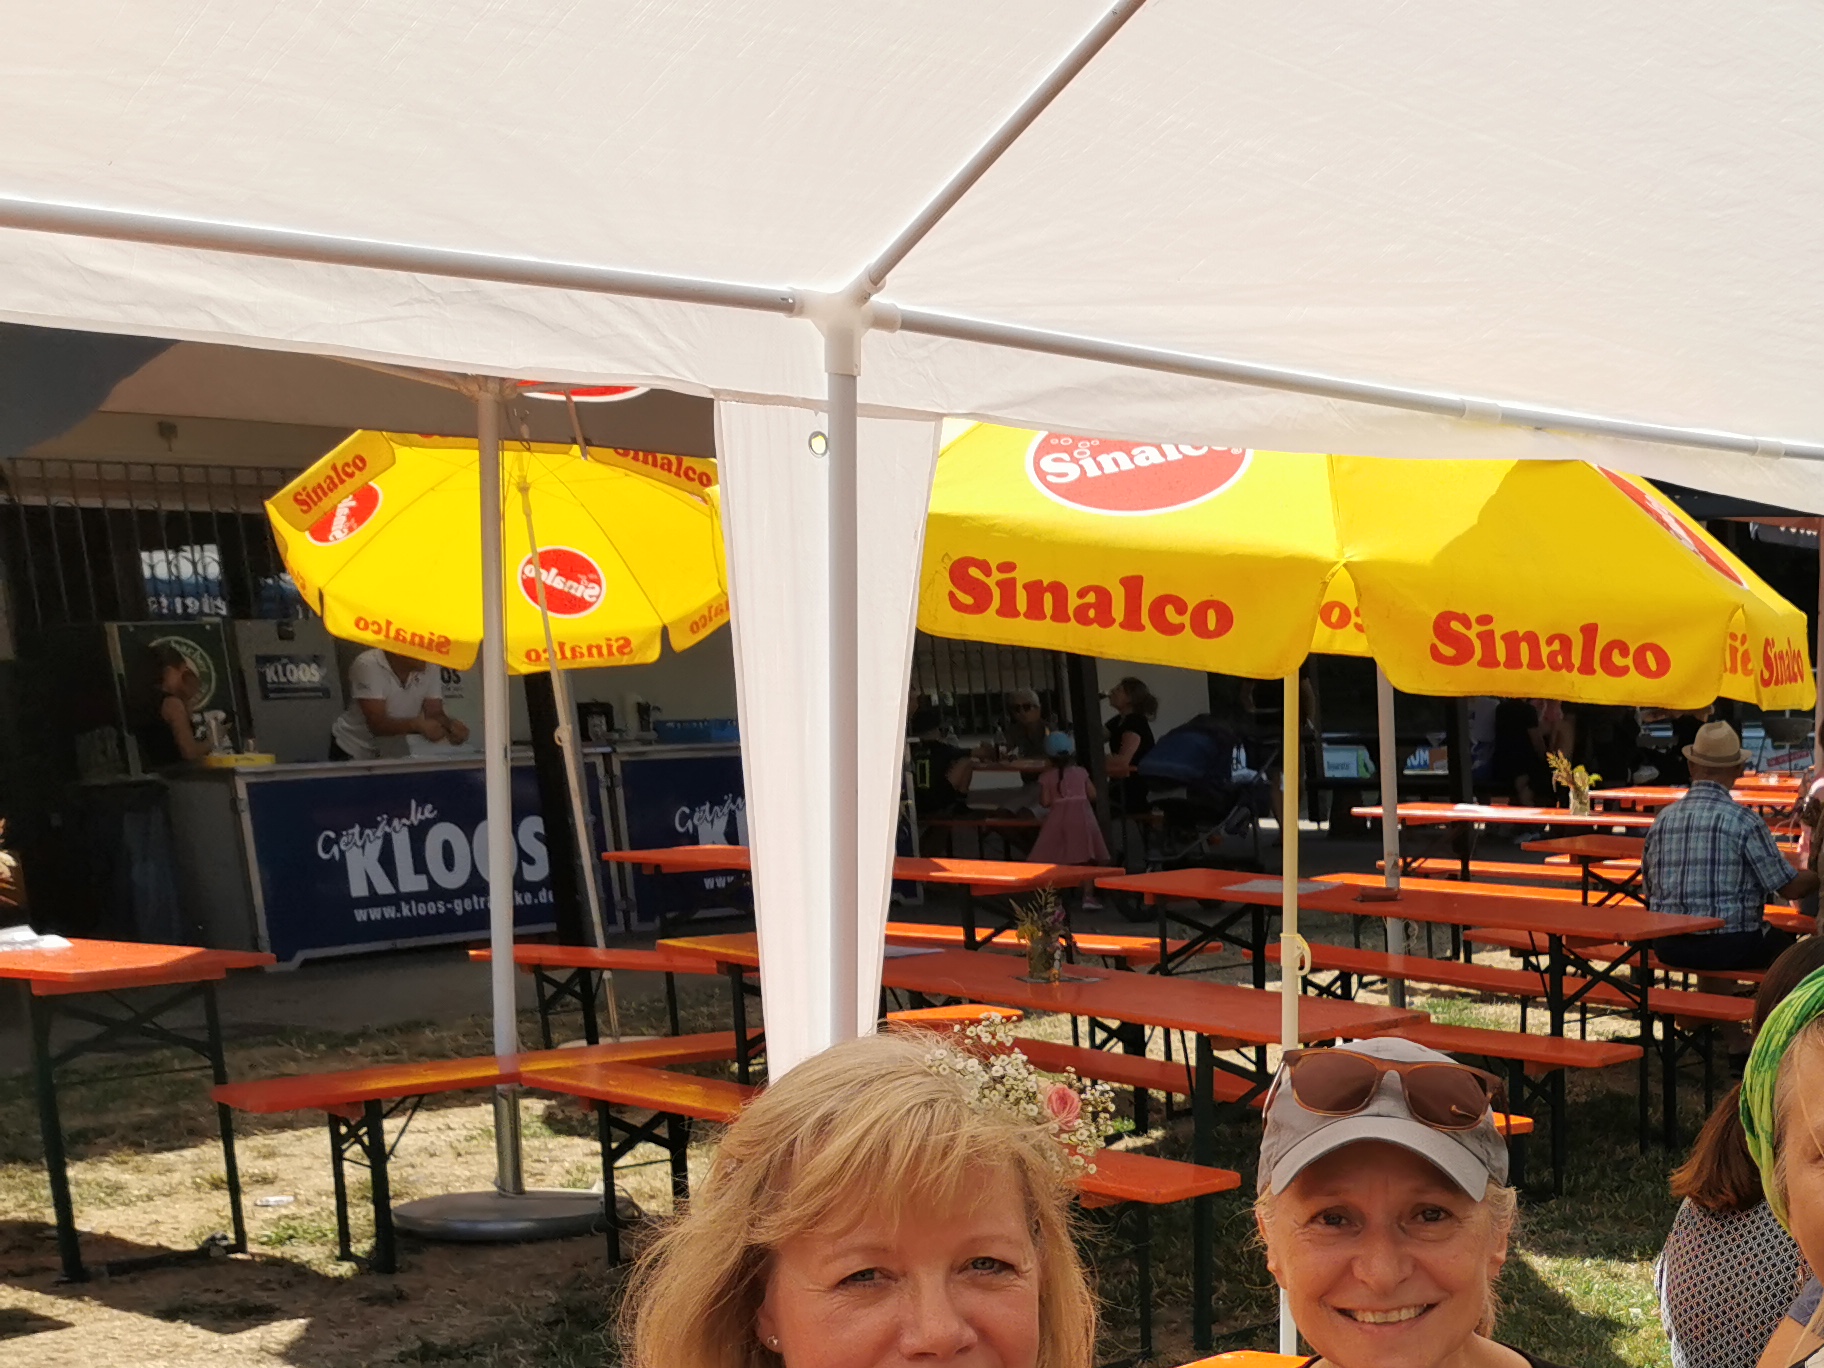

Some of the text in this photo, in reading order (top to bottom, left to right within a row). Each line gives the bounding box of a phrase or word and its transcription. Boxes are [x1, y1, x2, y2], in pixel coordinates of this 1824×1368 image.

[293, 454, 368, 515] Sinalco
[1039, 444, 1228, 484] Sinalc
[948, 556, 1234, 639] Sinalco
[1430, 611, 1671, 679] Sinalco
[1760, 637, 1805, 688] Sinalco
[317, 799, 438, 861] Getränke
